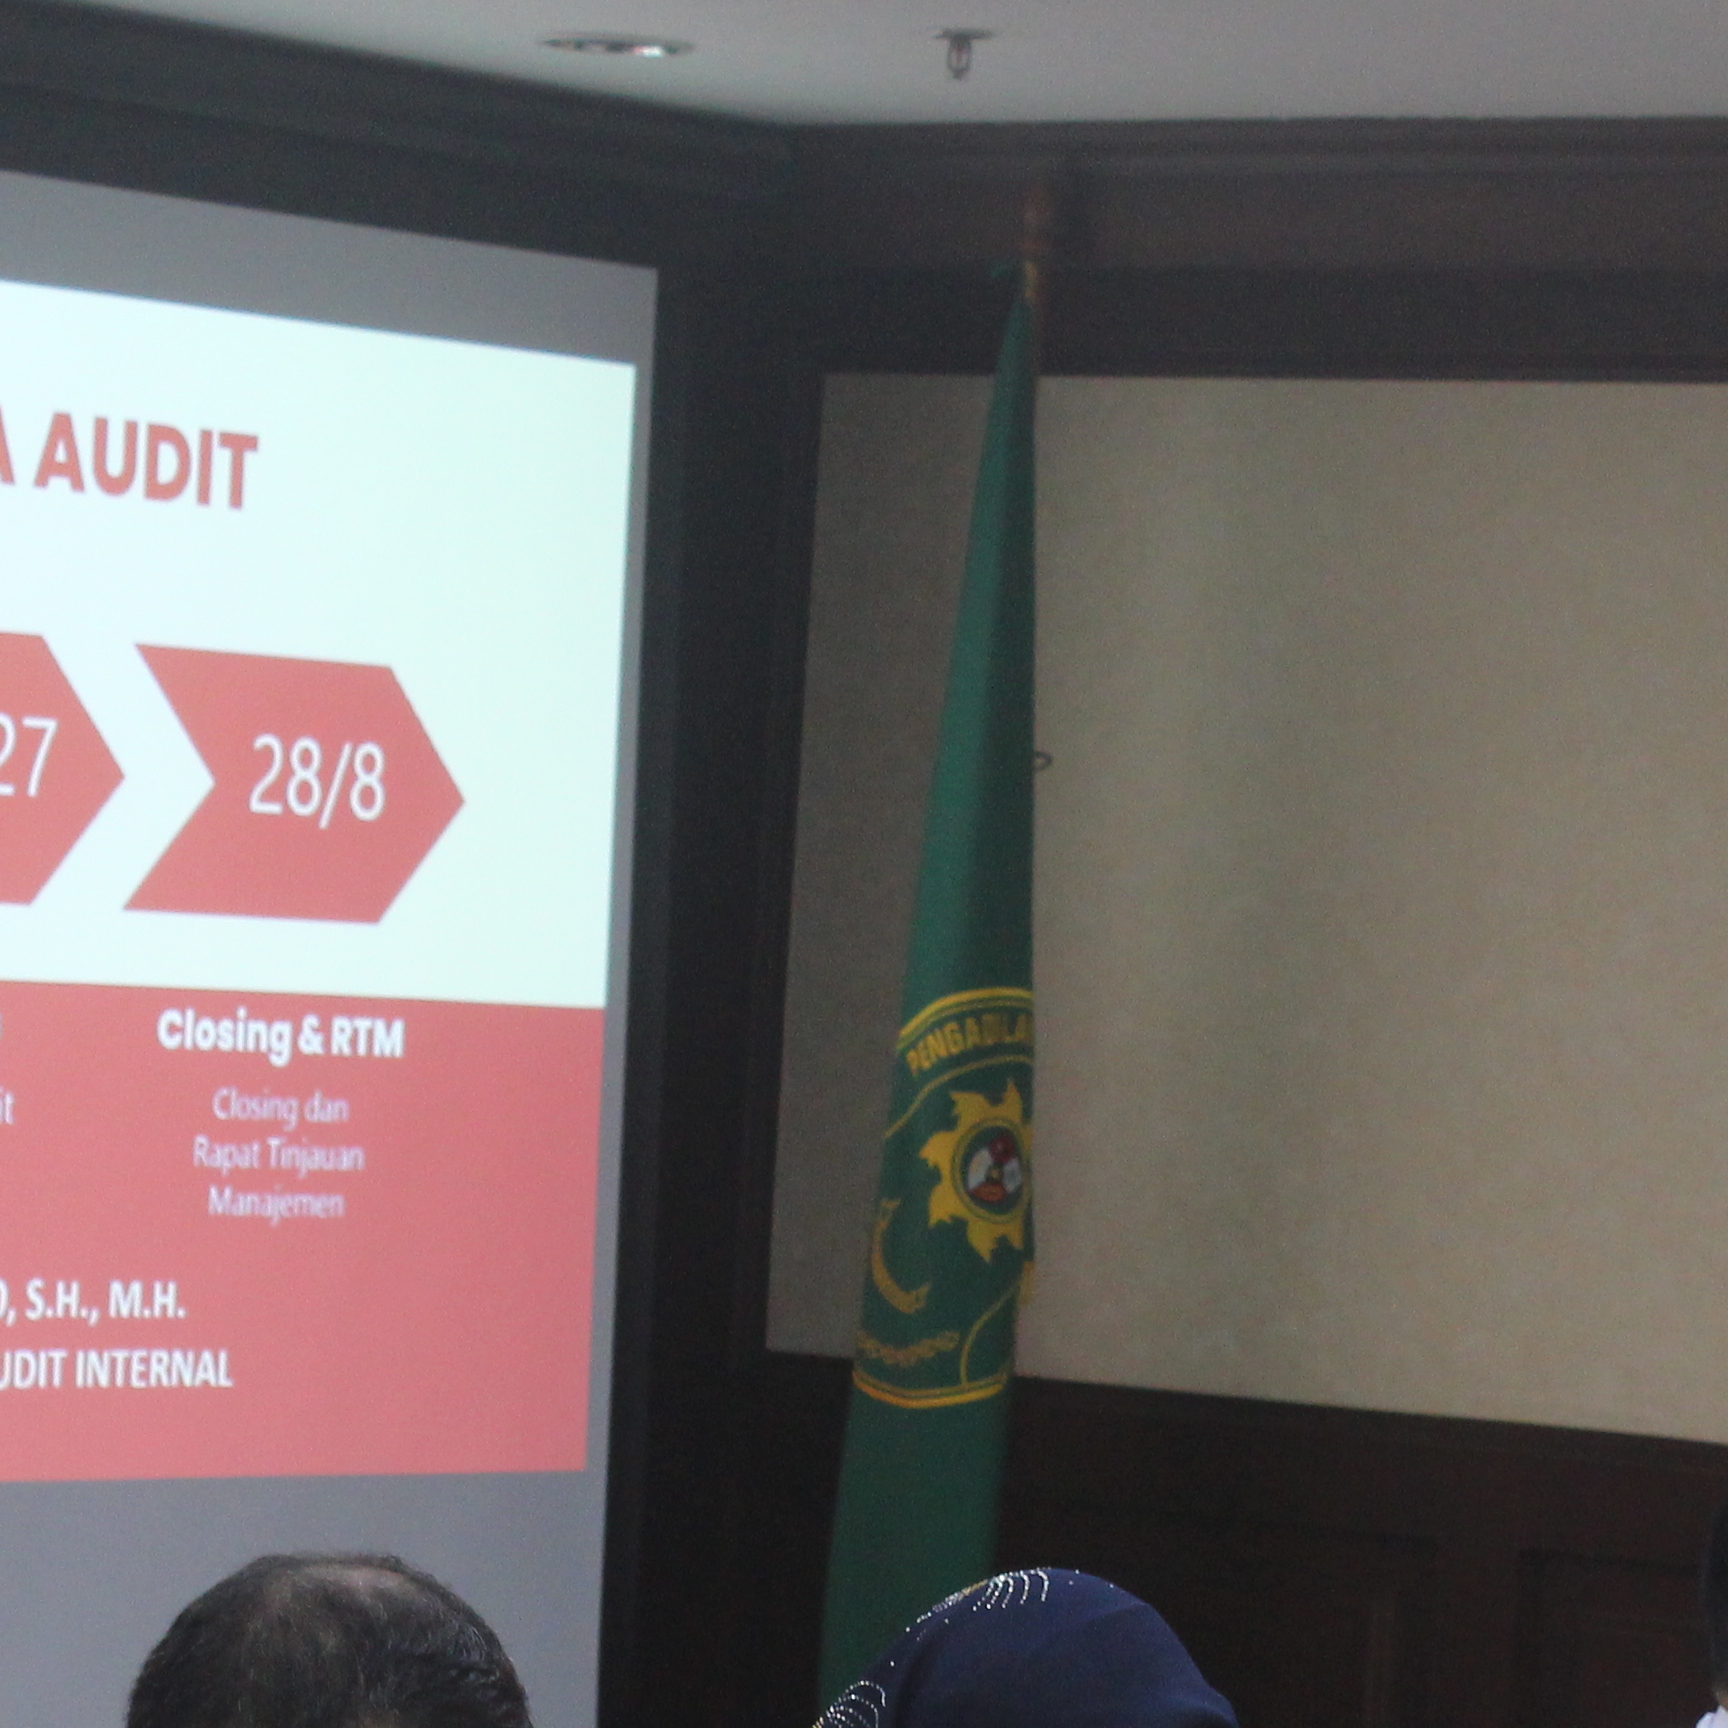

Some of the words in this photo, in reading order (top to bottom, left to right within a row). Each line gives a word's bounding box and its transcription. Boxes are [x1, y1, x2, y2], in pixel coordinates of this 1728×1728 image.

[34, 412, 259, 510] AUDIT
[250, 734, 385, 829] 28/8
[158, 1007, 293, 1067] Closing
[298, 1015, 324, 1054] &
[331, 1016, 404, 1057] RTM
[212, 1087, 299, 1131] Closing
[304, 1091, 349, 1123] dan
[194, 1134, 260, 1175] Rapat
[267, 1136, 364, 1178] Tinjauan
[208, 1185, 344, 1225] Manajemen
[25, 1278, 99, 1325] S.H.,
[109, 1281, 186, 1318] M.H.
[76, 1349, 232, 1388] INTERNAL
